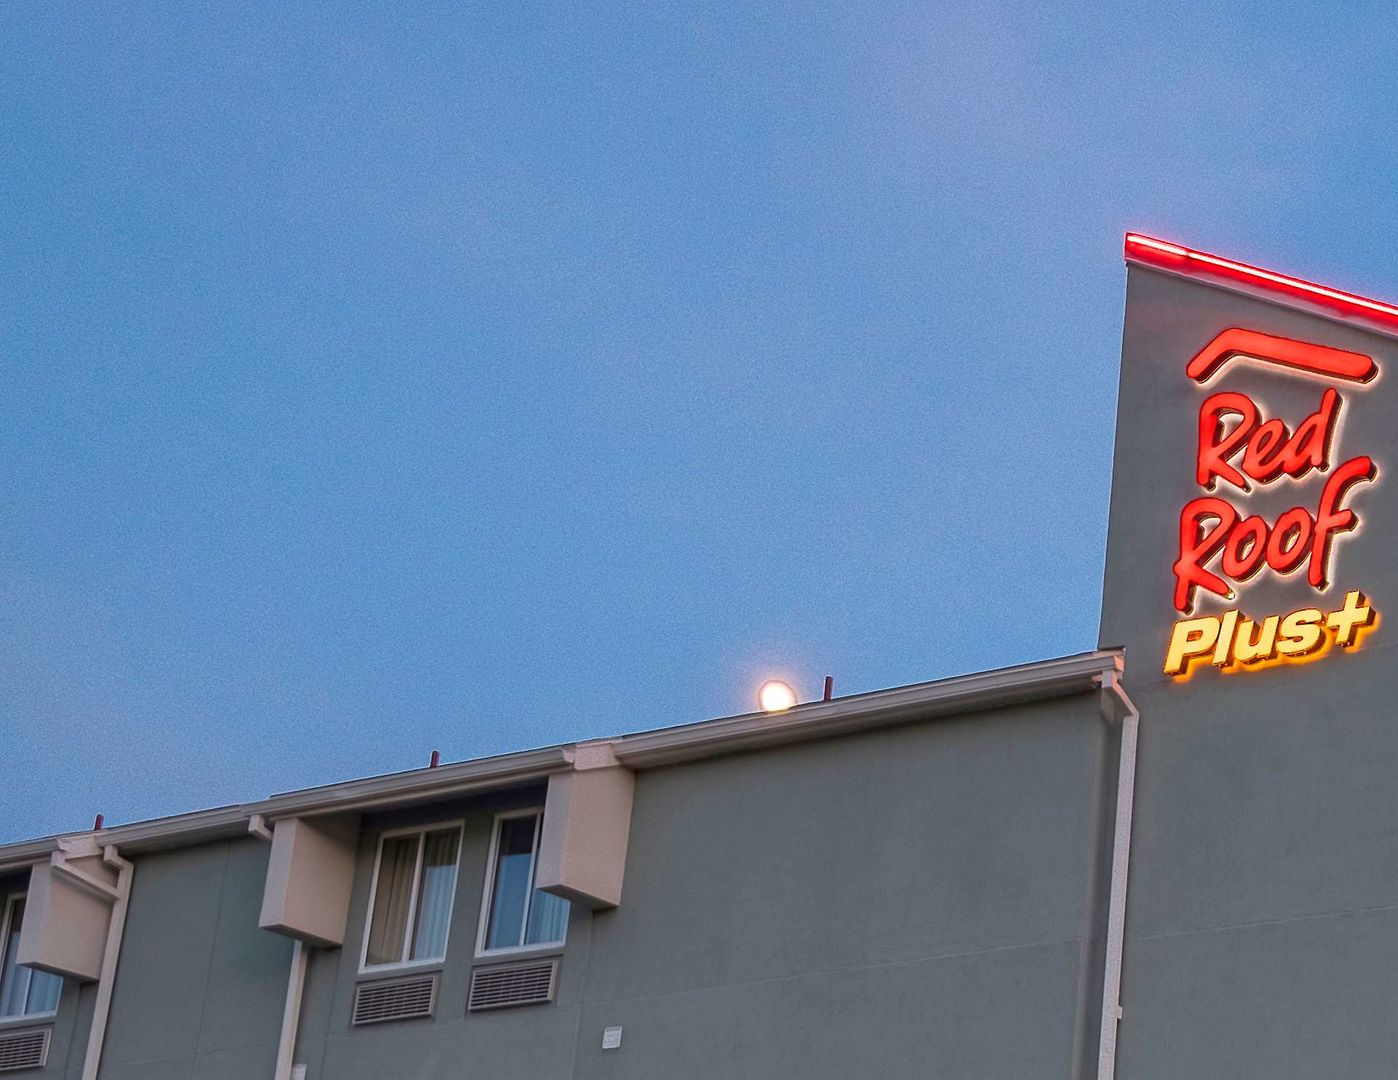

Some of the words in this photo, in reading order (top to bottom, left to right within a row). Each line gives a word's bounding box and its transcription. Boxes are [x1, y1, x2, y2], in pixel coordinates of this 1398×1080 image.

[1197, 388, 1341, 492] Red
[1173, 456, 1377, 614] Roof
[1163, 590, 1375, 675] Plus+
